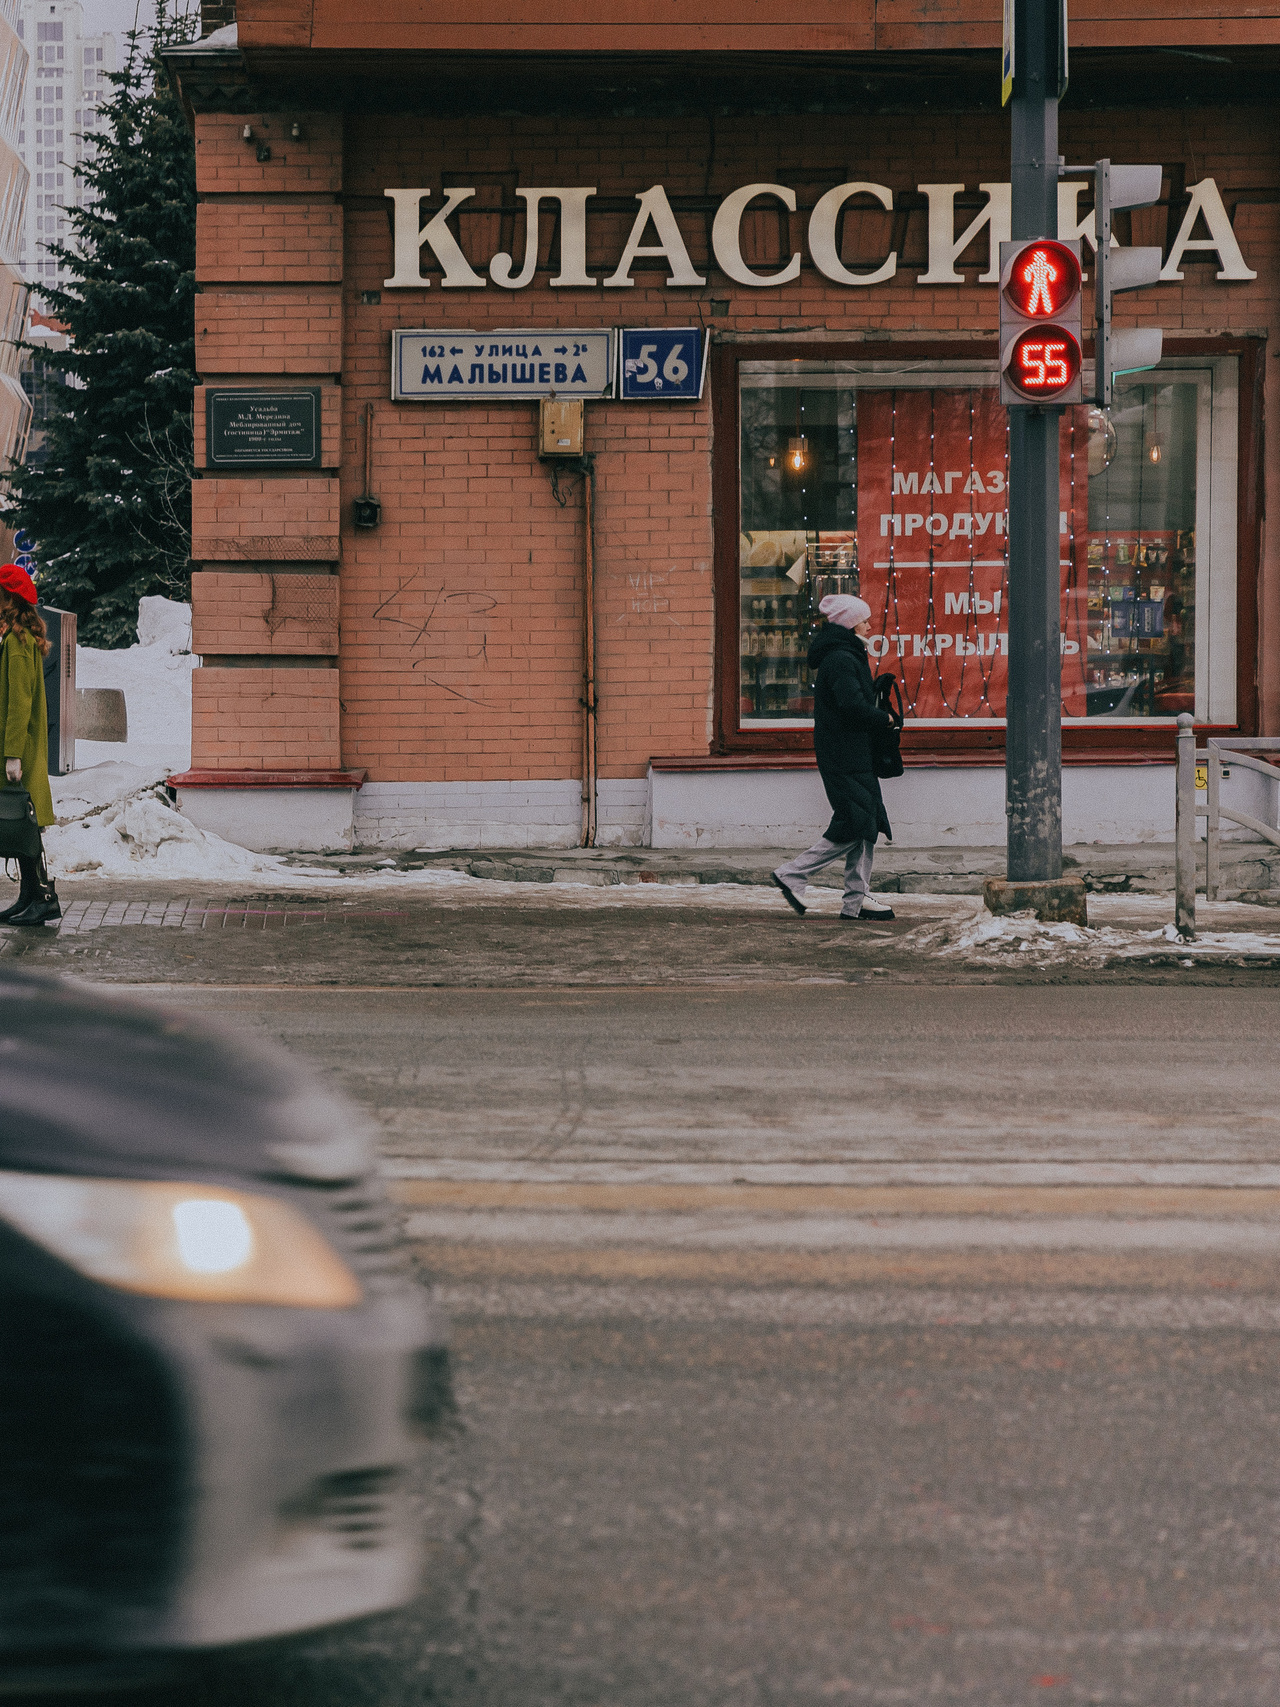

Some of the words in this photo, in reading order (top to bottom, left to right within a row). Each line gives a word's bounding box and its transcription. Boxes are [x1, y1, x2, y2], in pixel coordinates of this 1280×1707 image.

[421, 345, 445, 358] 162
[474, 344, 542, 359] УЛИЦА
[421, 363, 588, 384] МАЛЫШЕВА
[636, 344, 689, 384] 56
[1022, 344, 1067, 385] 55
[944, 591, 1002, 615] МЫ
